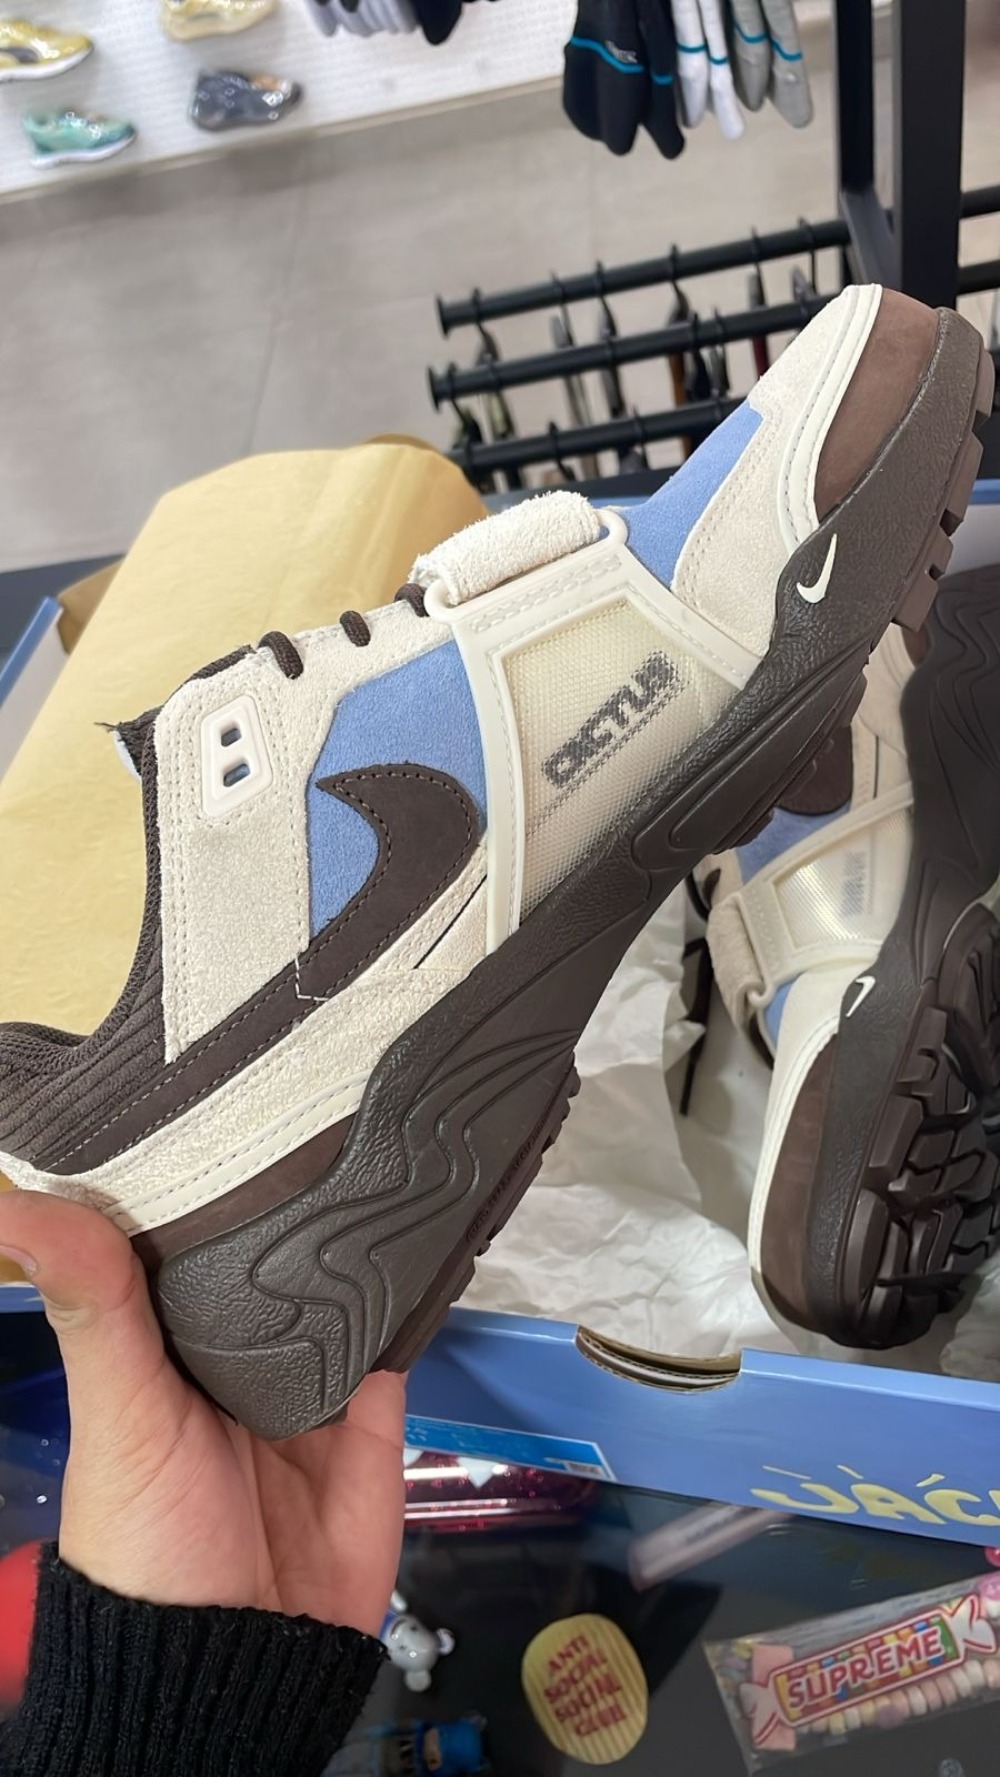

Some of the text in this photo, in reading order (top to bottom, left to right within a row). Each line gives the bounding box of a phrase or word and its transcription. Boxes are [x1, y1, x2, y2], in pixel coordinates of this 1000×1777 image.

[541, 651, 680, 788] CACTUS
[750, 1482, 1000, 1526] JAC
[547, 1634, 589, 1675] ANTI
[787, 1627, 945, 1709] SUPREME
